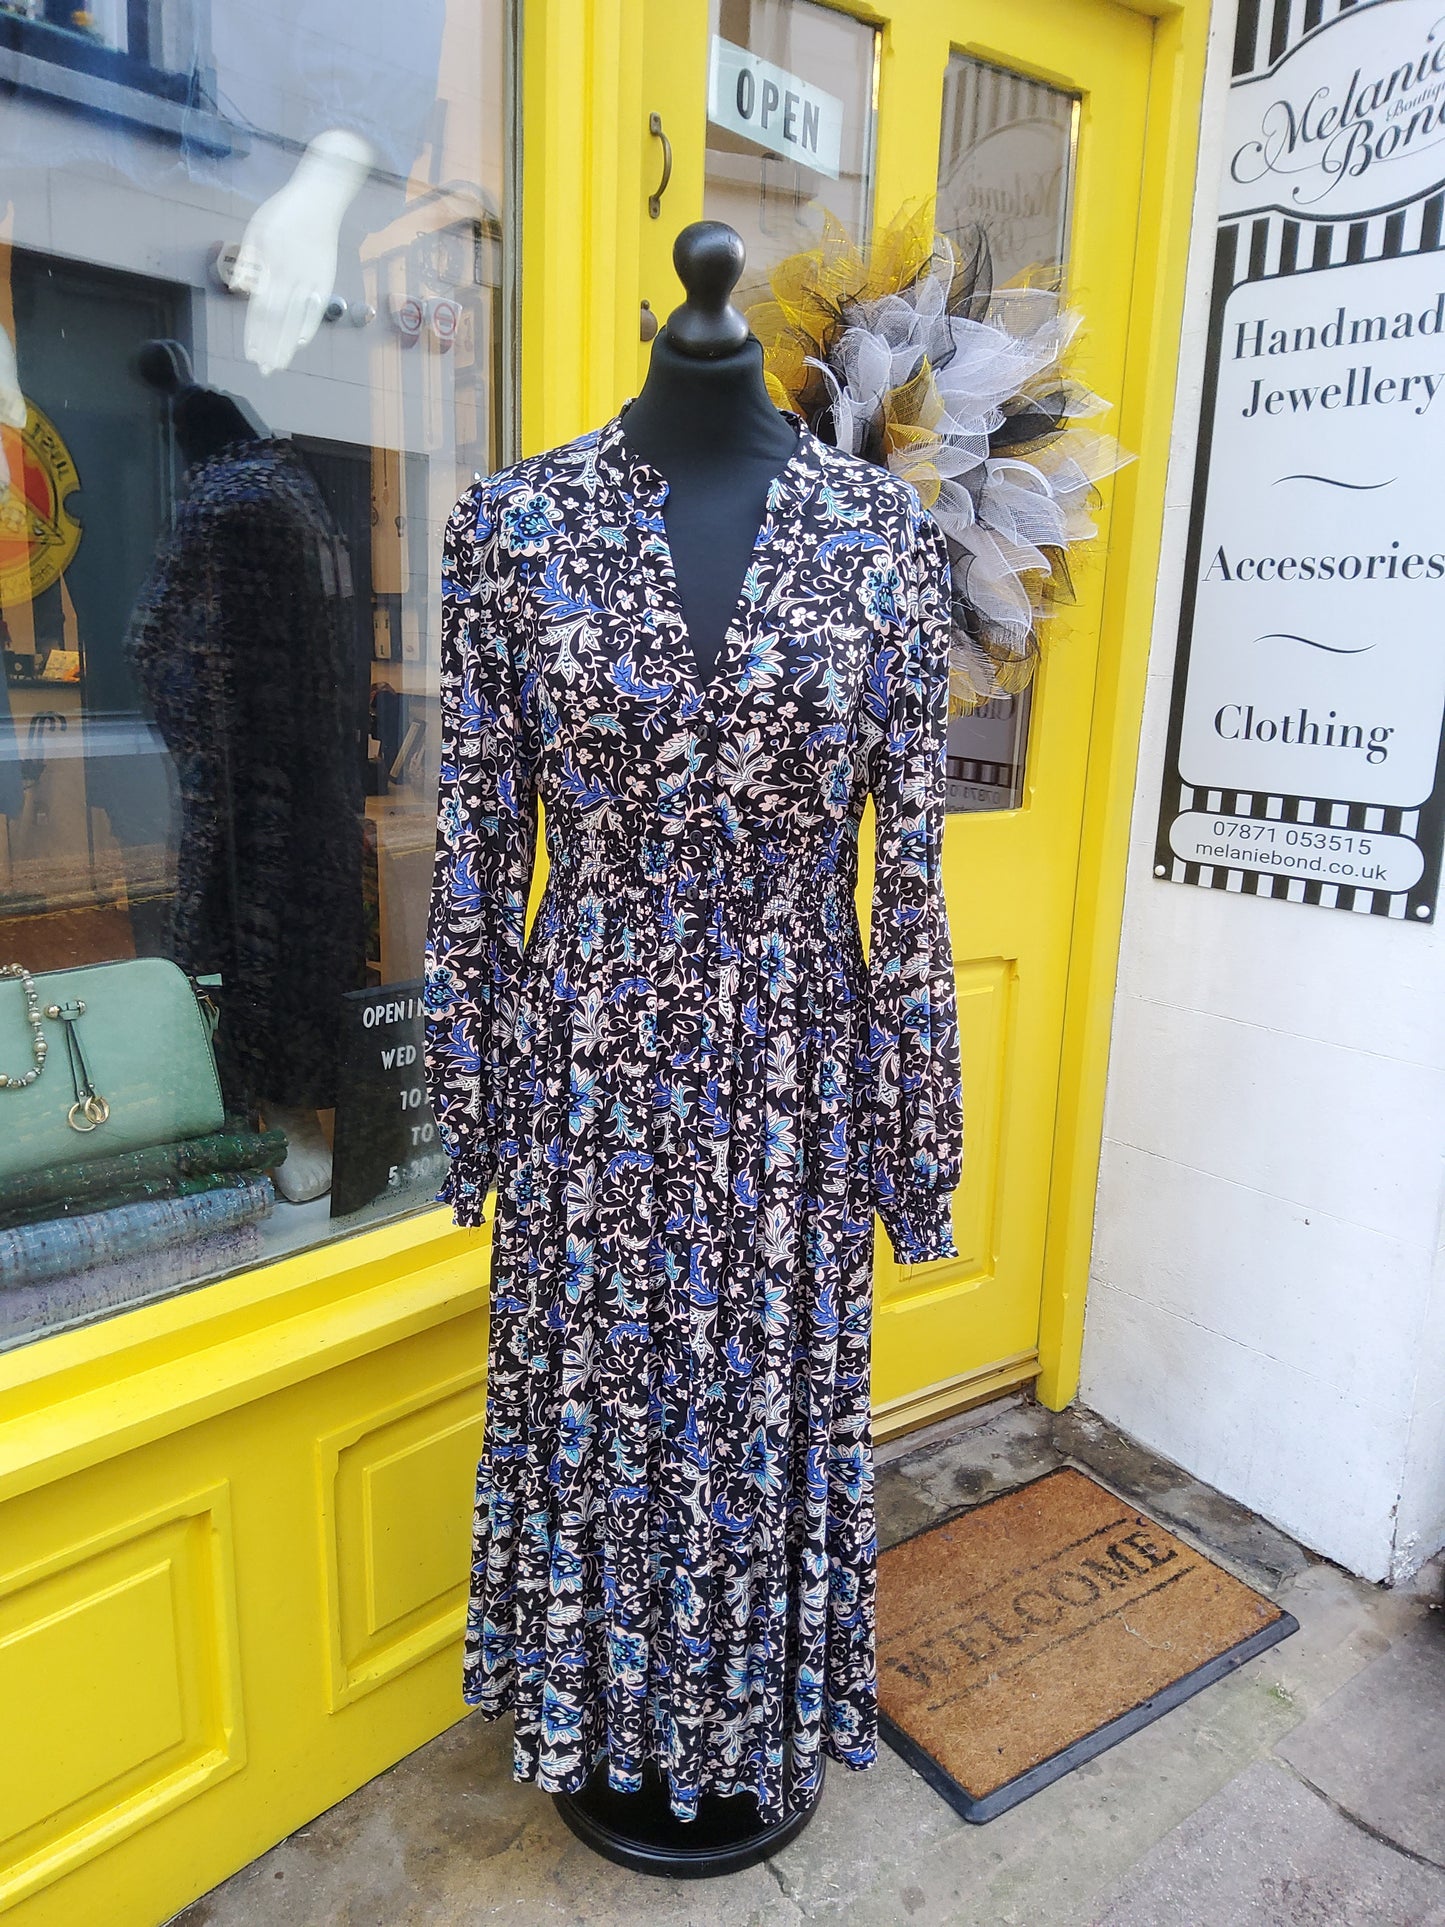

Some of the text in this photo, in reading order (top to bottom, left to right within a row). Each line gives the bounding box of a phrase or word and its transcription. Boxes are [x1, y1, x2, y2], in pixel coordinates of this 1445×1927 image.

[736, 68, 820, 153] OPEN
[1232, 292, 1445, 361] Handmad
[1242, 365, 1445, 418] Jewellery
[1201, 540, 1445, 583] Accessories
[1214, 704, 1395, 765] Clothing
[1195, 843, 1389, 881] melaniebond.co.uk
[1213, 821, 1373, 856] 07871 053515
[381, 1045, 417, 1071] WED
[411, 1123, 435, 1146] TO
[884, 1531, 1178, 1688] WELCOME
